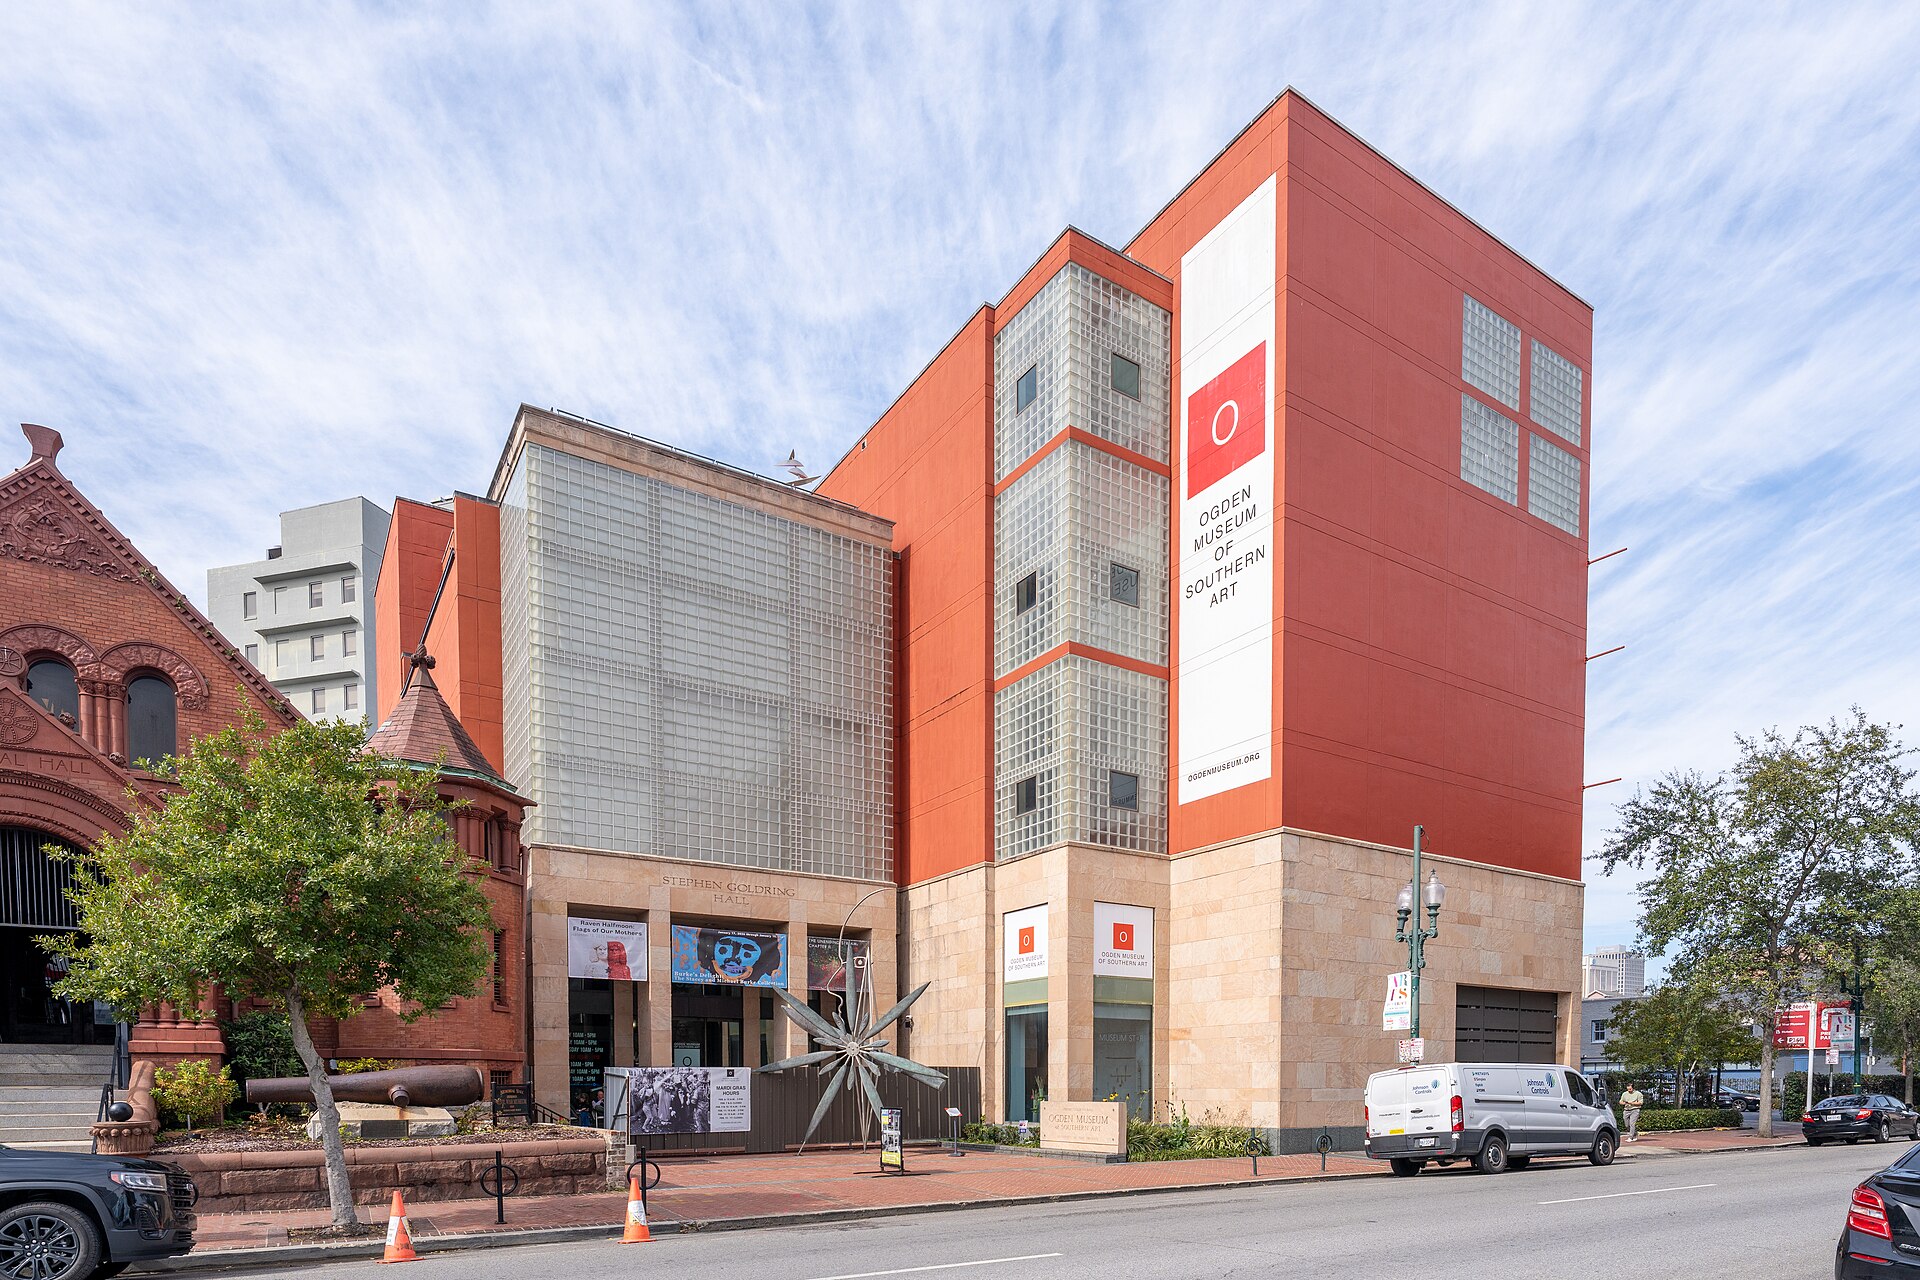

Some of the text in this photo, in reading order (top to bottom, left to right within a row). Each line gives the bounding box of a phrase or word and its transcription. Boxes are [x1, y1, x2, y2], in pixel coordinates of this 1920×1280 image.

[1199, 484, 1251, 527] OGDEN
[1194, 503, 1256, 552] MUSEUM
[1214, 539, 1234, 561] OF
[1186, 544, 1265, 599] SOUTHERN
[1210, 581, 1238, 609] ART
[39, 756, 91, 775] HALL
[1188, 752, 1260, 782] OGDENMUSEUM.ORG
[662, 875, 796, 898] STEPHEN GOLDRING
[713, 894, 750, 906] HALL
[1010, 954, 1043, 965] OGDEN MUSEUM
[1101, 951, 1121, 959] OGDEN
[1107, 958, 1137, 966] SOUTHERN
[1014, 962, 1037, 971] SOUTHERN
[1526, 1079, 1545, 1087] Johnson
[1530, 1087, 1550, 1095] Controls
[1048, 1114, 1109, 1125] OGDEN MUSEUM
